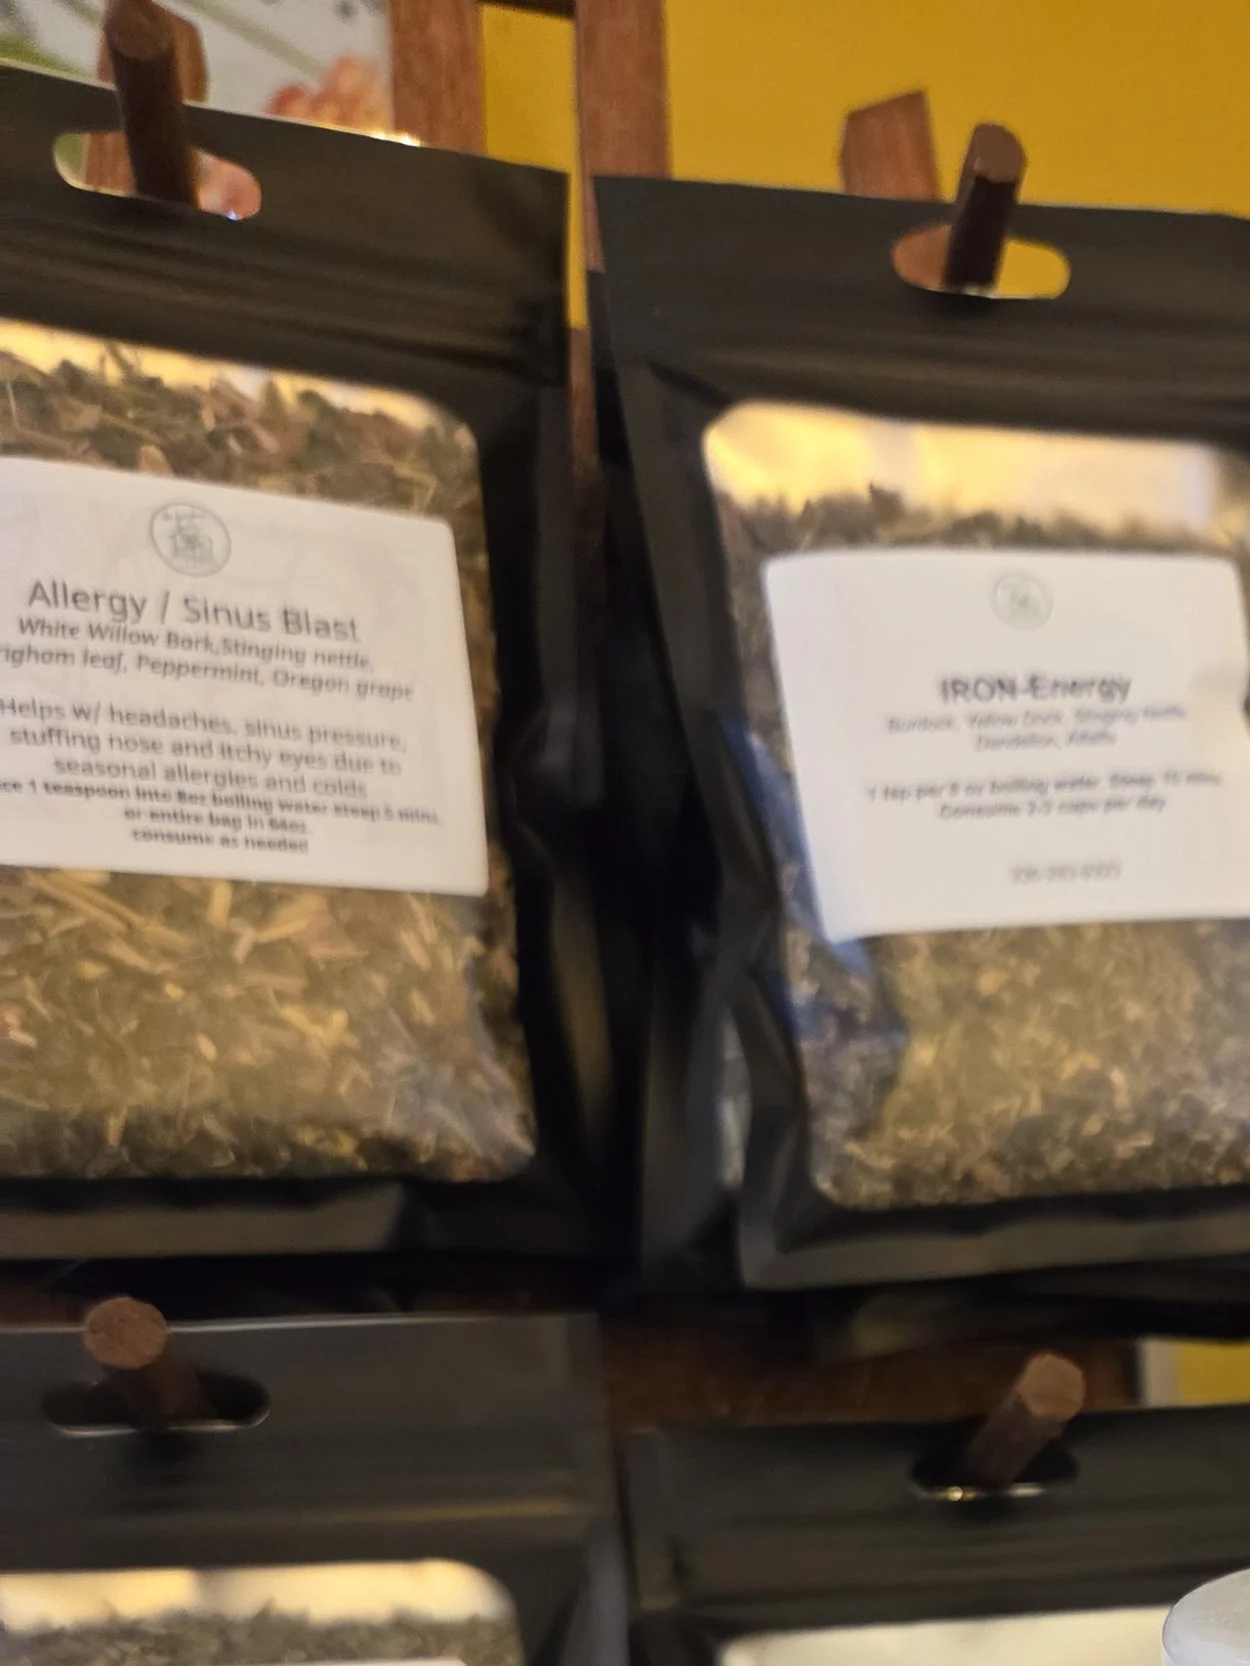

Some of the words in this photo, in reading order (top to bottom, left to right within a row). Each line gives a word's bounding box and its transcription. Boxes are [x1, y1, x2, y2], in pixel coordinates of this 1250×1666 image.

[19, 617, 80, 640] White
[88, 622, 158, 646] Willow
[28, 577, 147, 624] Allergy
[160, 589, 170, 624] /
[183, 593, 271, 632] Sinus
[282, 606, 361, 643] Blast
[82, 648, 127, 676] leaf,
[137, 652, 264, 688] Peppermint,
[273, 668, 350, 697] Oregon
[356, 680, 414, 702] grape
[0, 697, 66, 723] Helps
[72, 702, 100, 724] w/
[245, 717, 301, 741] sinus
[10, 726, 101, 755] stuffing
[108, 733, 163, 754] nose
[171, 736, 214, 759] and
[220, 742, 271, 770] itchy
[280, 751, 328, 773] eyes
[334, 751, 373, 773] due
[379, 756, 402, 776] to
[54, 756, 156, 781] seasonal
[164, 760, 257, 790] allergies
[265, 774, 306, 794] and
[312, 777, 367, 800] colds
[44, 780, 130, 799] teaspoon
[135, 784, 172, 804] into
[212, 791, 273, 816] boiling
[278, 799, 328, 816] water
[334, 803, 380, 823] steep
[124, 807, 142, 821] or
[150, 808, 204, 827] entire
[208, 811, 242, 832] bag
[247, 815, 264, 831] in
[133, 828, 214, 845] consume
[219, 834, 239, 849] as
[244, 835, 309, 855] needed
